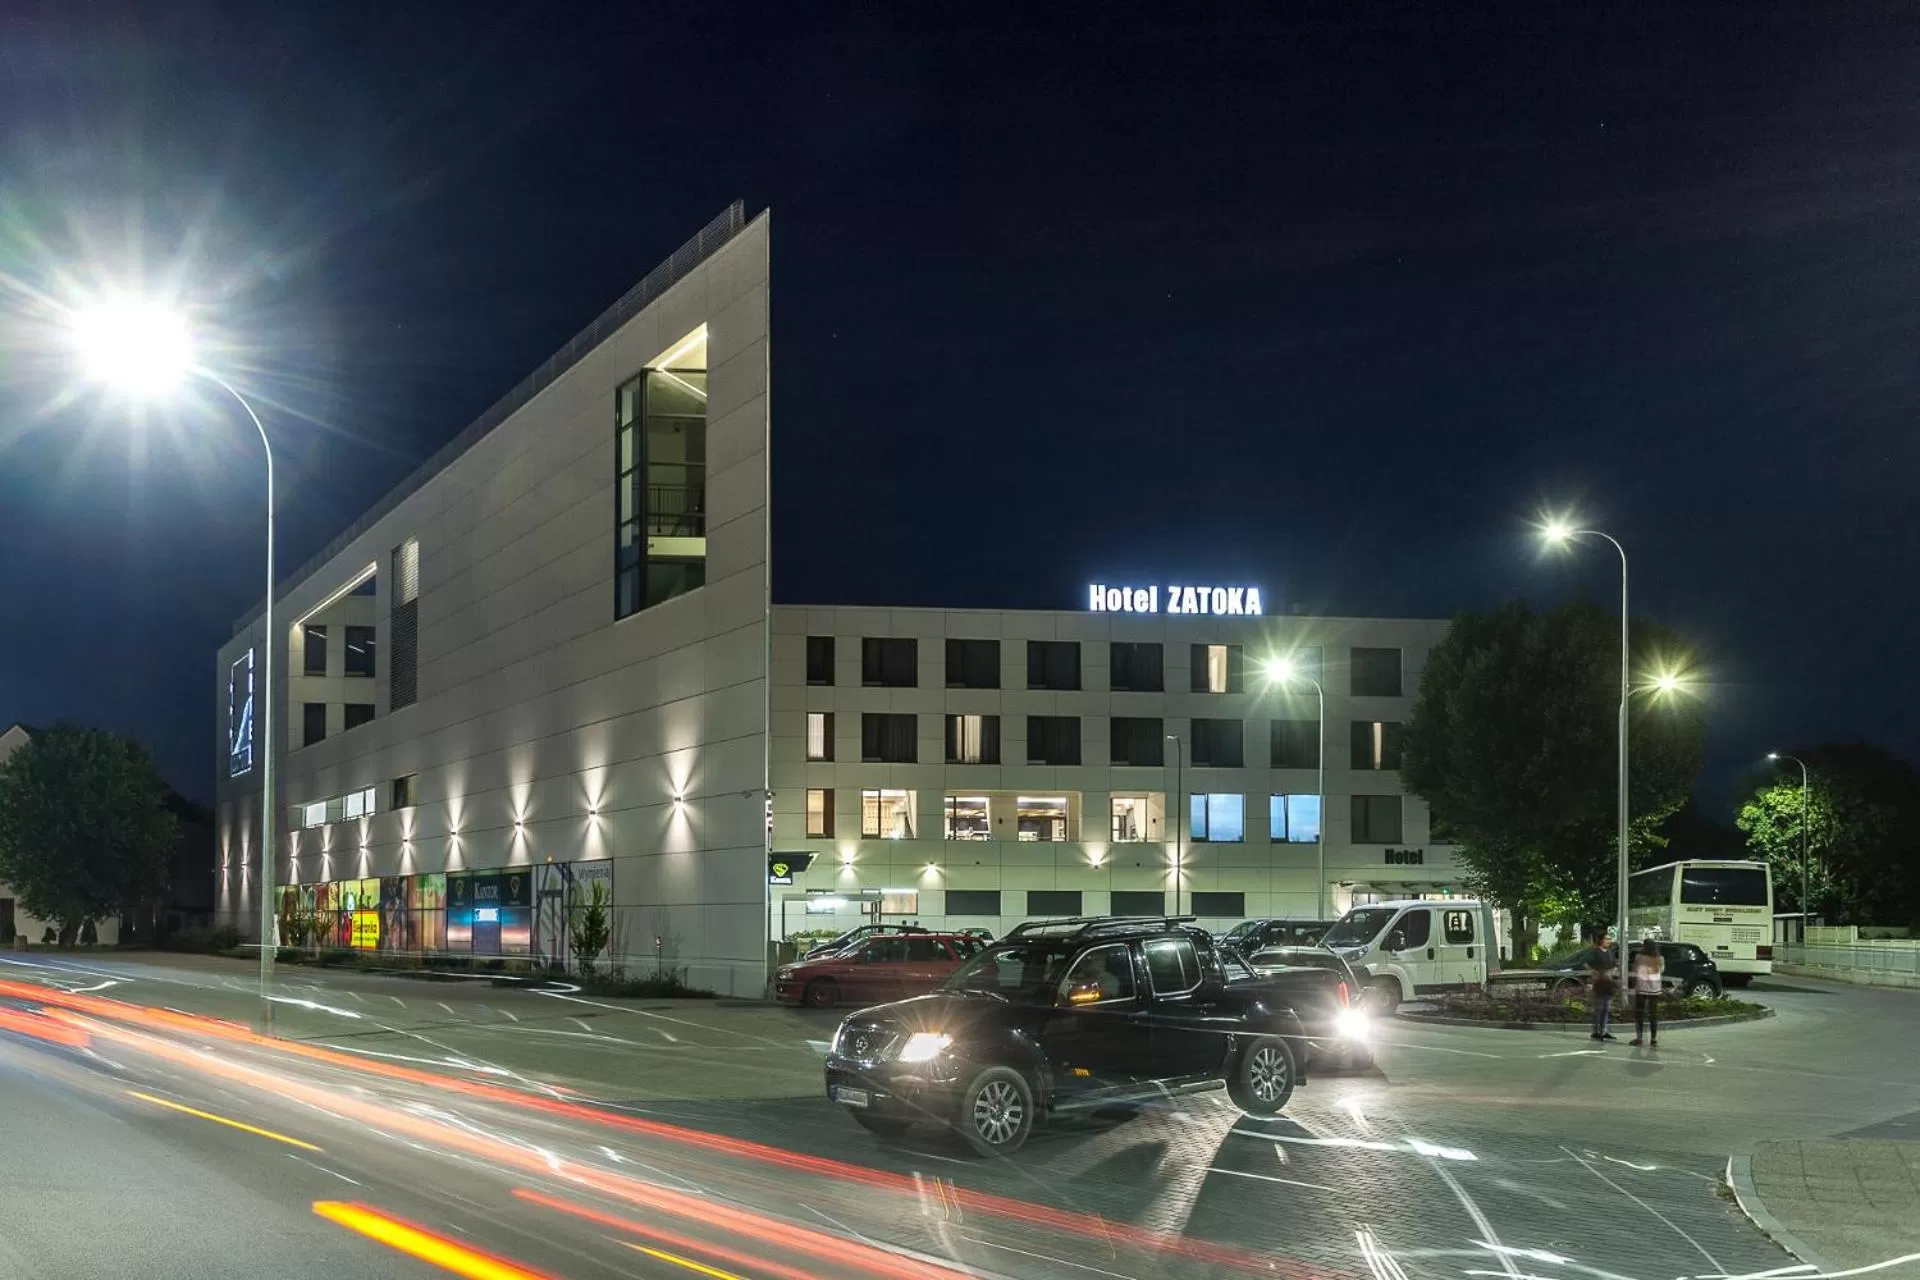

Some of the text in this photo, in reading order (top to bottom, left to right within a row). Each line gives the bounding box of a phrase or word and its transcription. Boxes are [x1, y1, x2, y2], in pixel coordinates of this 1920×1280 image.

[1088, 584, 1262, 615] Hotel ZATOKA
[1384, 848, 1423, 865] Hotel
